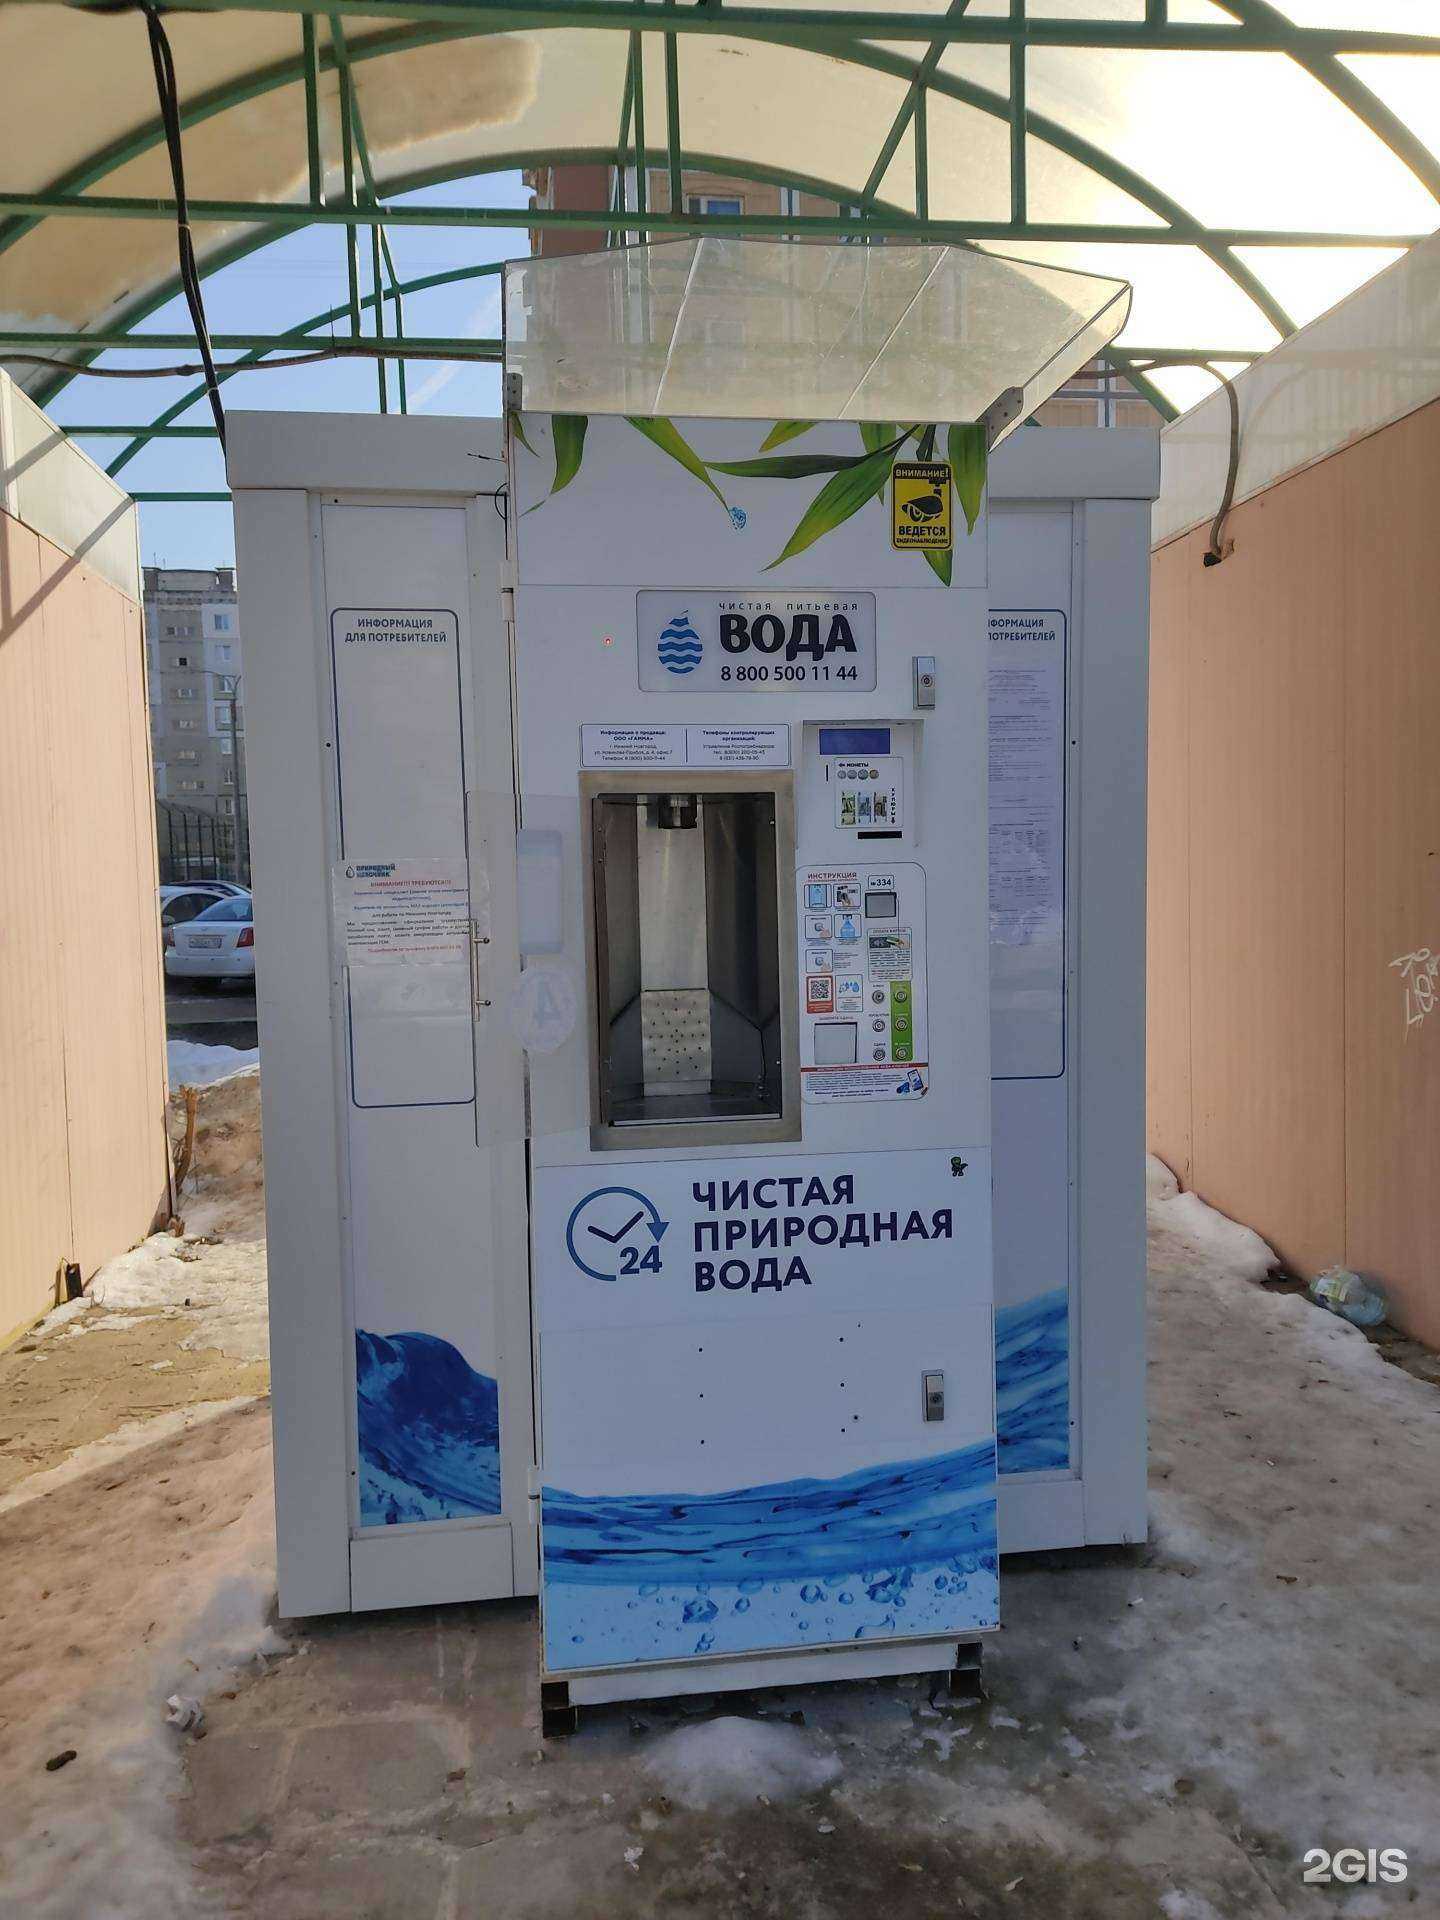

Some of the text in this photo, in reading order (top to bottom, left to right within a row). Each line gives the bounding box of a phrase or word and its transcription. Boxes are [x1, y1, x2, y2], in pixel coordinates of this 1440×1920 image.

[895, 467, 949, 478] ВНИМАНИЕ!
[898, 525, 946, 537] ВЕДЕТСЯ
[718, 602, 858, 611] чистая питьевая
[357, 619, 433, 629] ИНФОРМАЦИЯ
[988, 618, 1044, 629] ФОРМАЦИЯ
[344, 631, 447, 643] ДЛЯ ПОТРЕБИТЕЛЕЙ
[719, 613, 857, 661] ВОДА
[720, 665, 858, 681] 8 800 500 11 44
[807, 872, 857, 880] ИНСТРУКЦИЯ
[692, 1174, 855, 1212] ЧИСТАЯ
[694, 1208, 953, 1252] ПРИРОДНАЯ
[620, 1245, 663, 1275] 24
[694, 1255, 813, 1293] ВОДА
